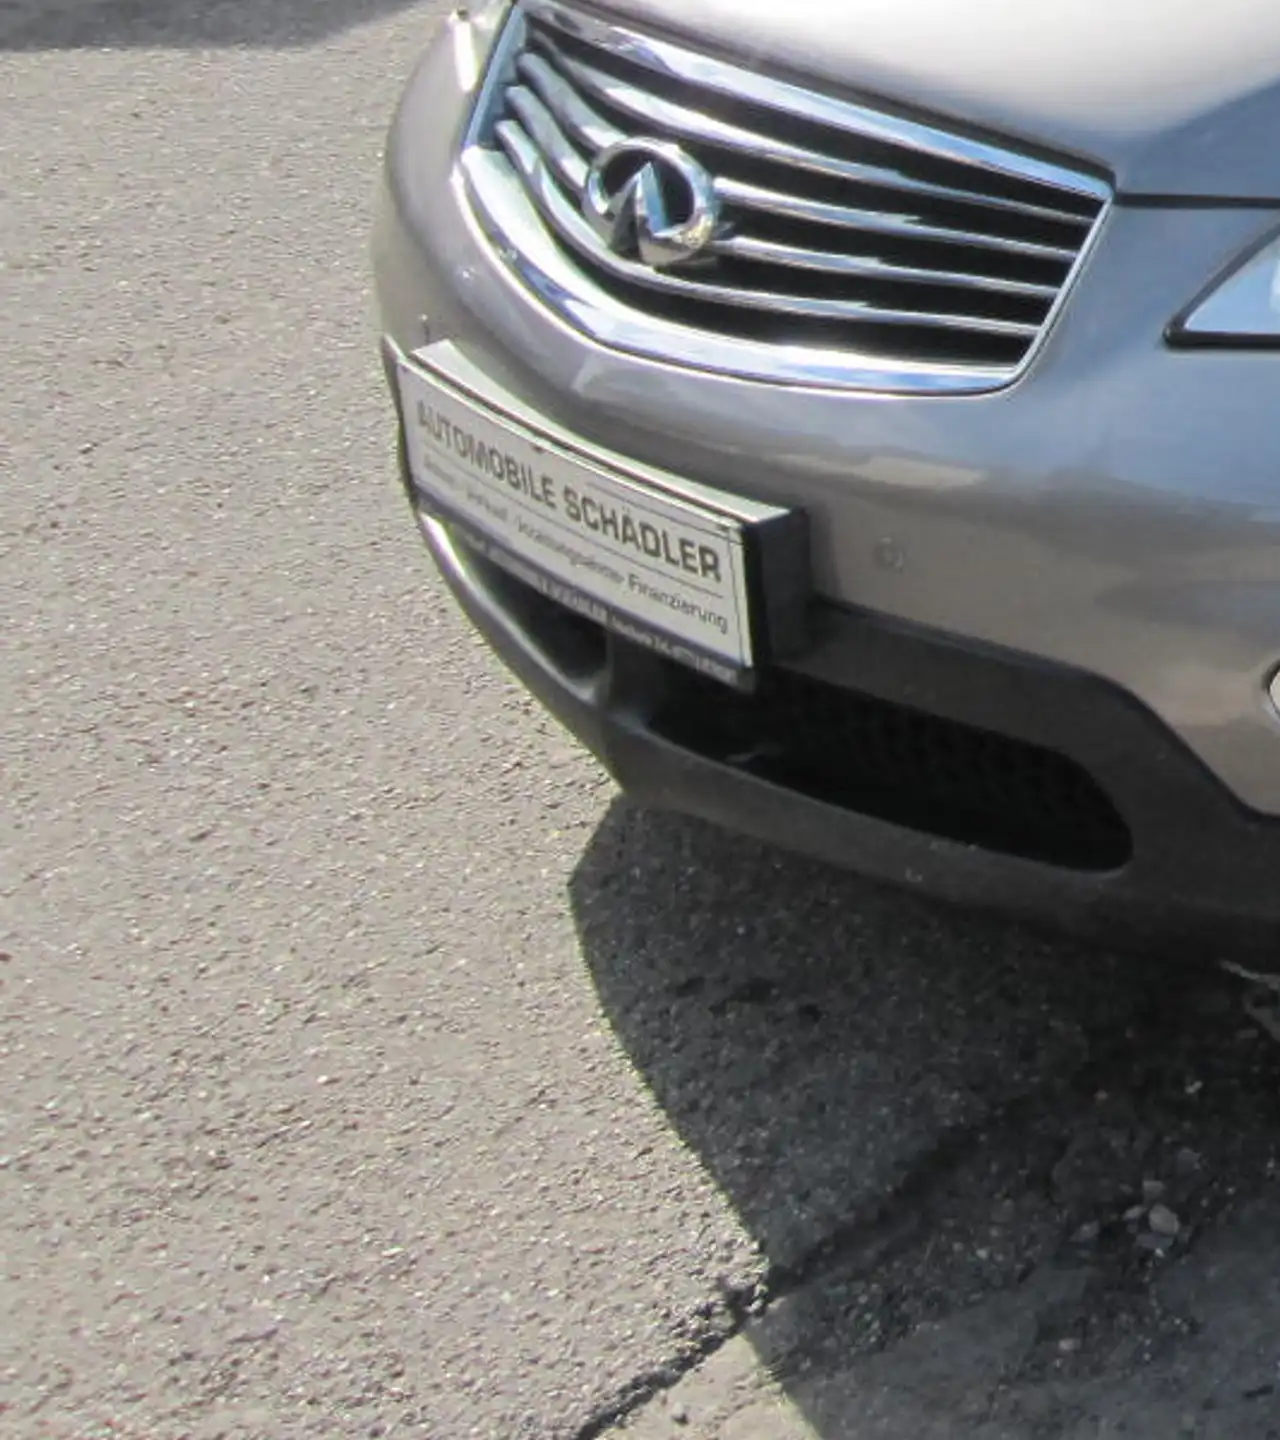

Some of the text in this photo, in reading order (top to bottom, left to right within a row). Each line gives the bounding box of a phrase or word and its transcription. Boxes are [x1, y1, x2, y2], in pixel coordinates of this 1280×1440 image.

[417, 399, 557, 510] AUTOMOBILE
[563, 484, 722, 584] SCHÄDLER
[627, 572, 729, 636] Finanzierung
